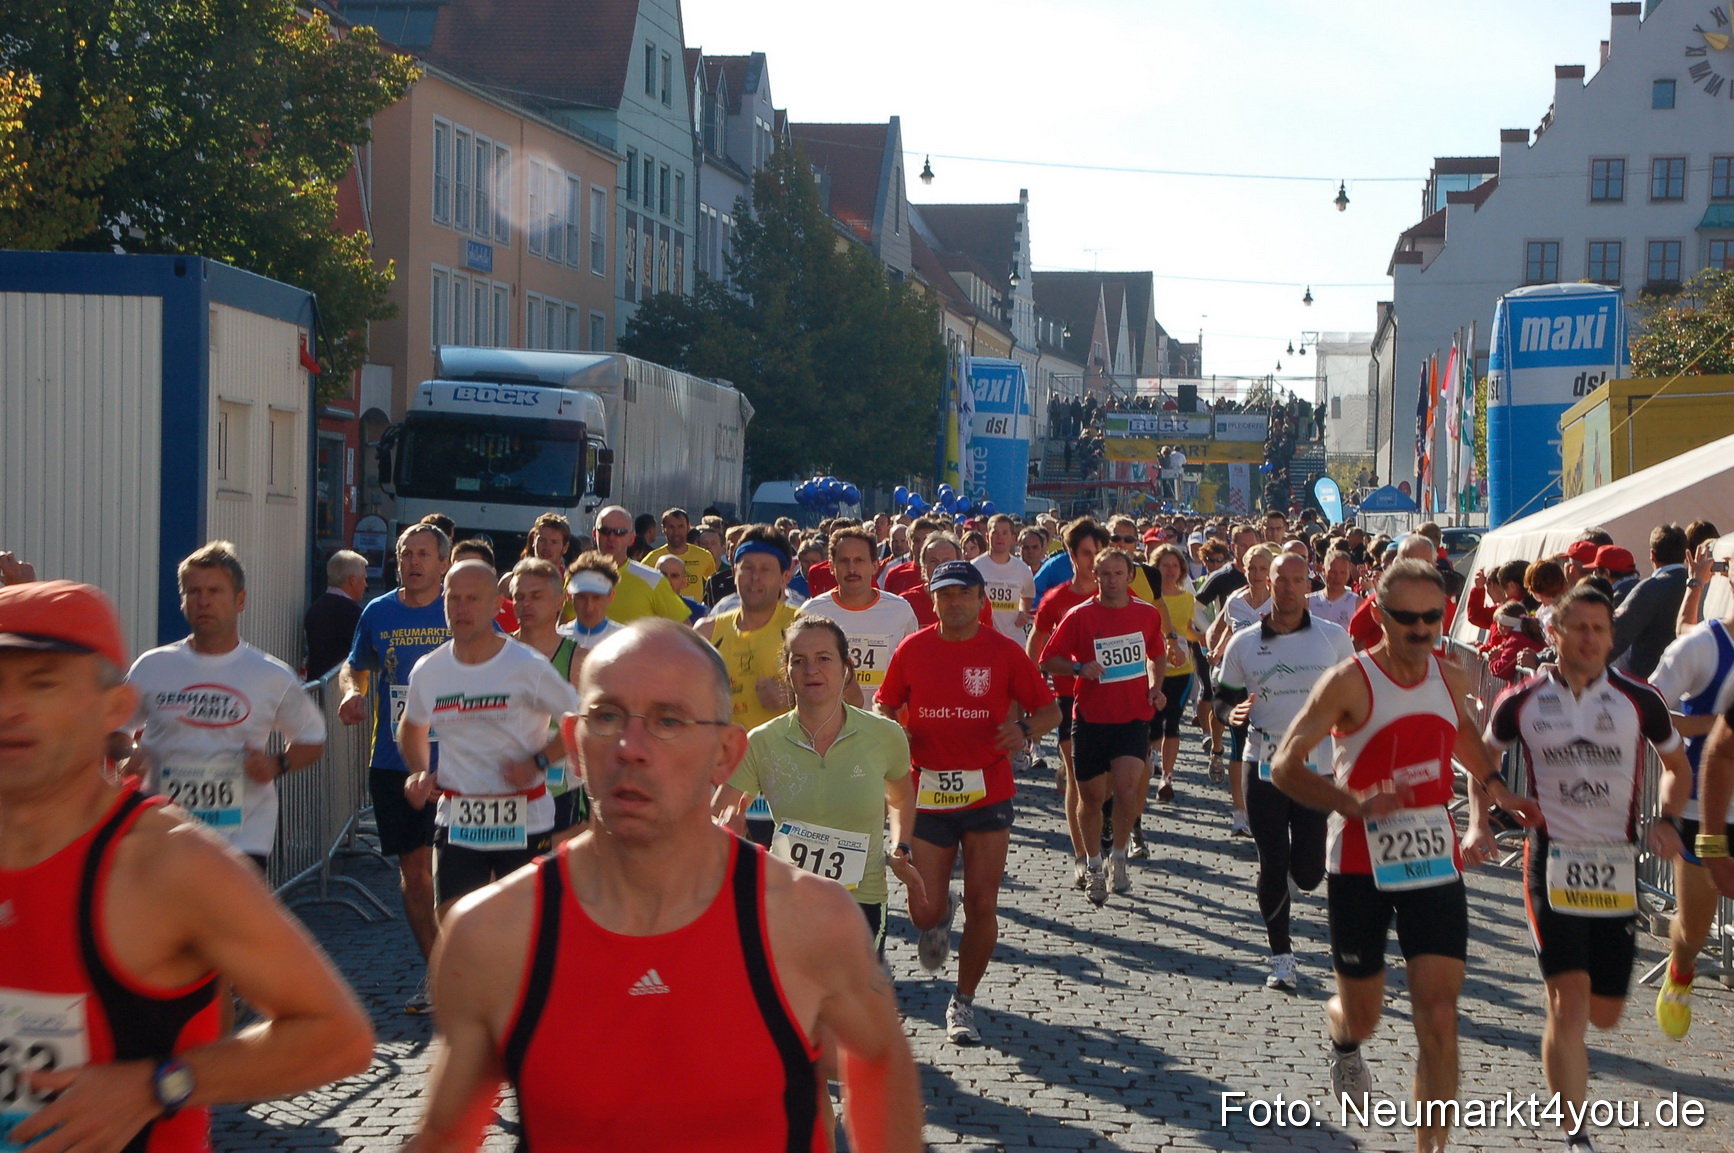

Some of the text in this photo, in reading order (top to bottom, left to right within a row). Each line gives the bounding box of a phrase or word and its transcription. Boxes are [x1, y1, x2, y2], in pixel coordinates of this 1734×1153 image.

[1519, 306, 1609, 352] maxi
[453, 386, 540, 406] BOCK
[971, 374, 1012, 403] axi
[985, 416, 1008, 435] dsl
[1128, 418, 1189, 432] BOCK
[989, 588, 1012, 601] 393
[380, 628, 453, 639] 10. NEUMARKTE
[389, 636, 445, 647] STADTLAUF
[850, 648, 875, 669] 34
[1102, 645, 1141, 667] 3509
[918, 706, 990, 719] Stadt-Team
[938, 771, 964, 792] 55
[168, 780, 234, 808] 2396
[933, 792, 970, 804] Charly
[459, 801, 517, 824] 3313
[790, 825, 830, 842] PFLEIDERER
[1378, 828, 1446, 861] 2255
[790, 842, 845, 881] 913
[1404, 861, 1432, 878] Karl
[1566, 862, 1616, 891] 832
[1565, 889, 1619, 908] Werner
